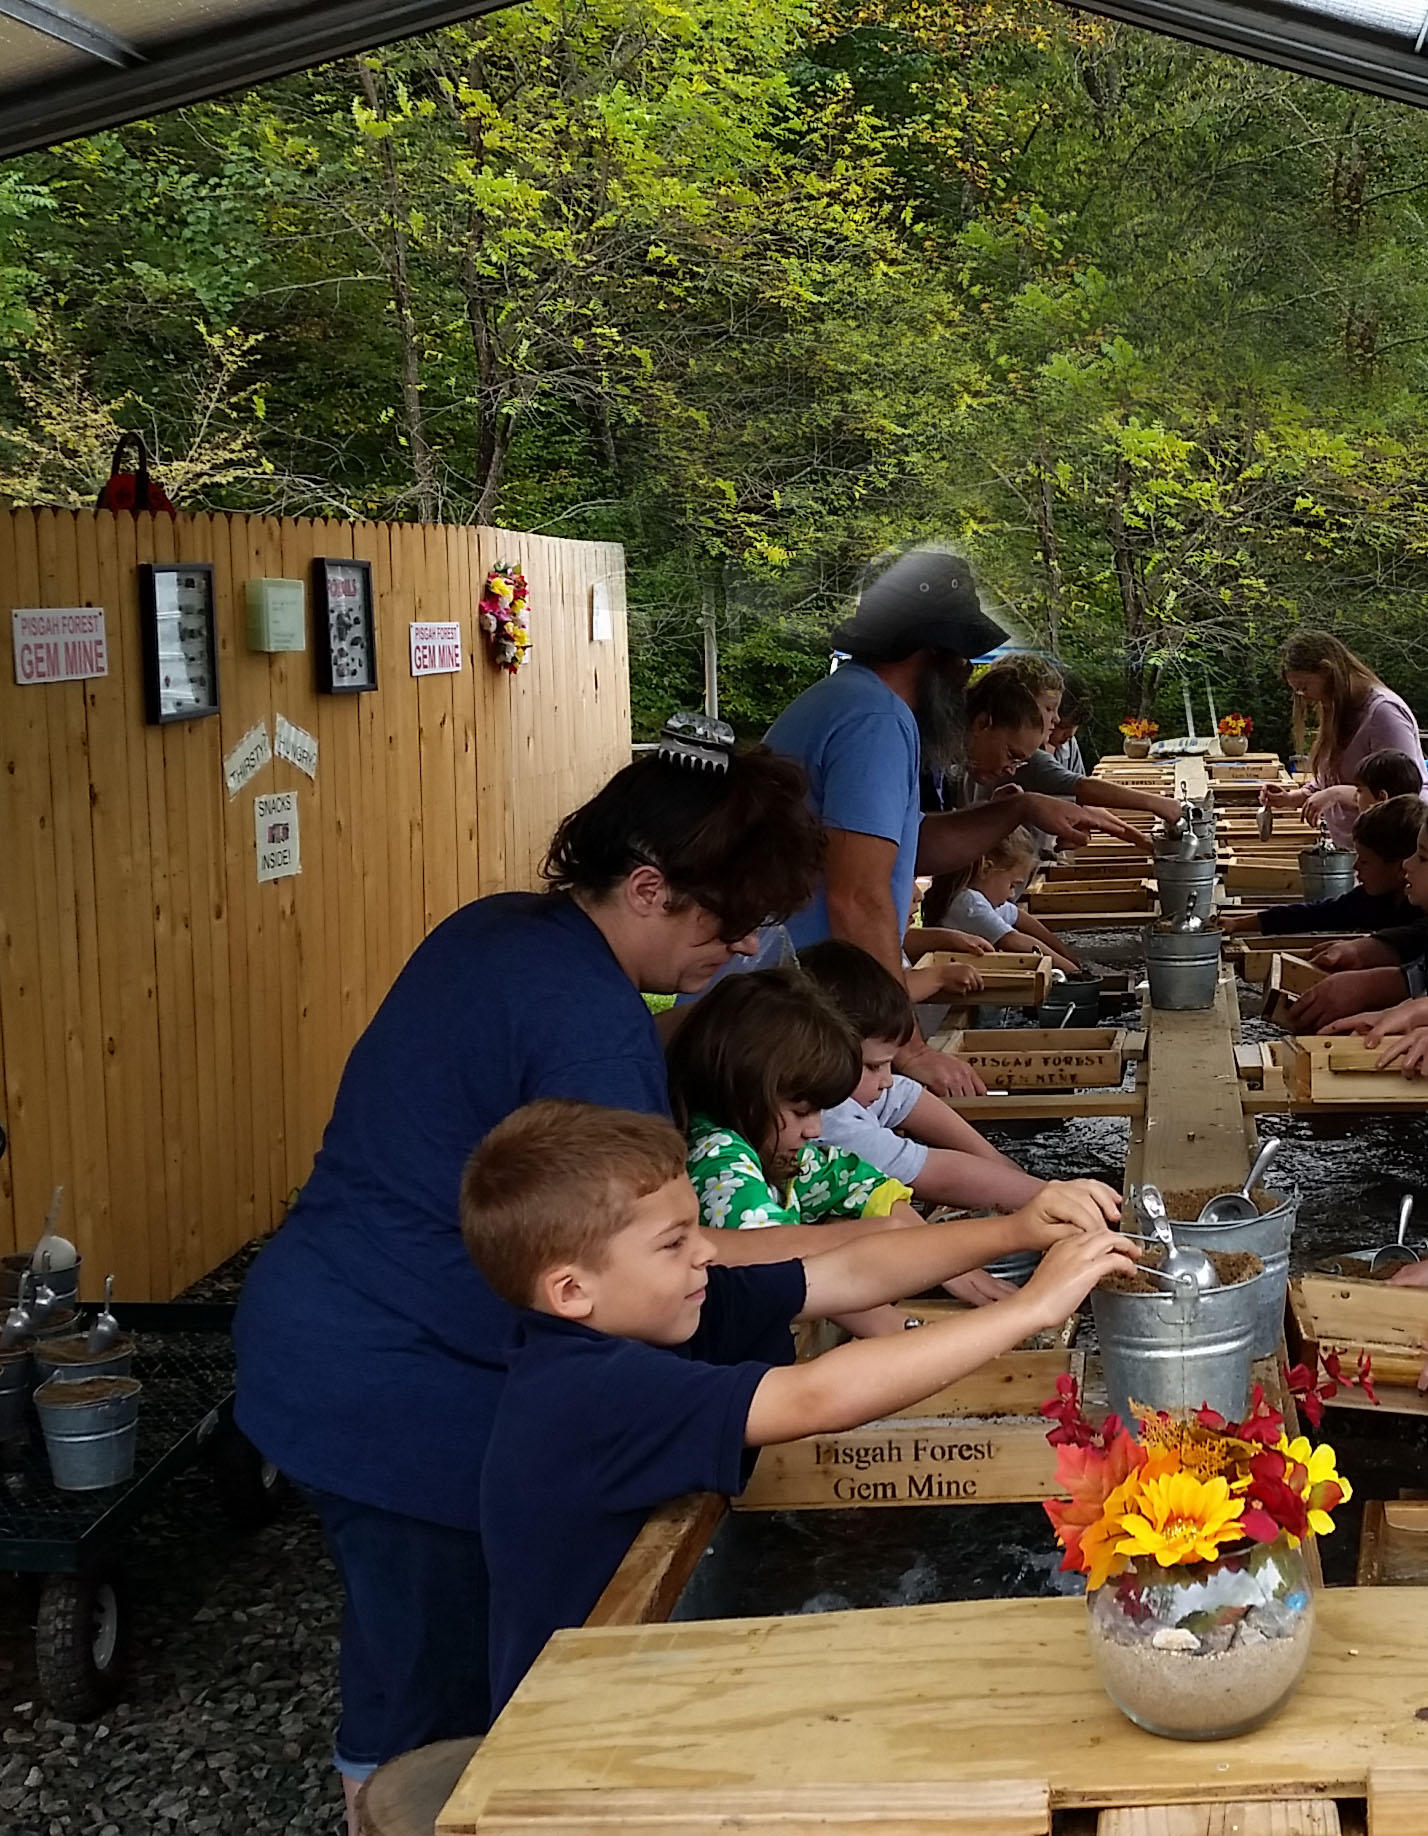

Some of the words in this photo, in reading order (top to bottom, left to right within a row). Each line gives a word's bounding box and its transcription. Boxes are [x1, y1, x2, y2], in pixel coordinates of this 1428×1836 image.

[21, 616, 60, 636] PISGAH
[62, 614, 99, 634] FOREST
[415, 627, 437, 640] PISGAH
[437, 627, 457, 640] FOREST
[21, 642, 60, 679] GEM
[64, 639, 105, 676] MINE
[414, 644, 437, 669] GEM
[438, 643, 460, 668] MINE
[229, 733, 268, 785] THIRSTY?
[258, 794, 292, 818] SNACKS
[261, 849, 292, 871] INSIDE!
[913, 1438, 995, 1463] Forest
[833, 1476, 897, 1501] Gem
[907, 1472, 978, 1500] Mine
